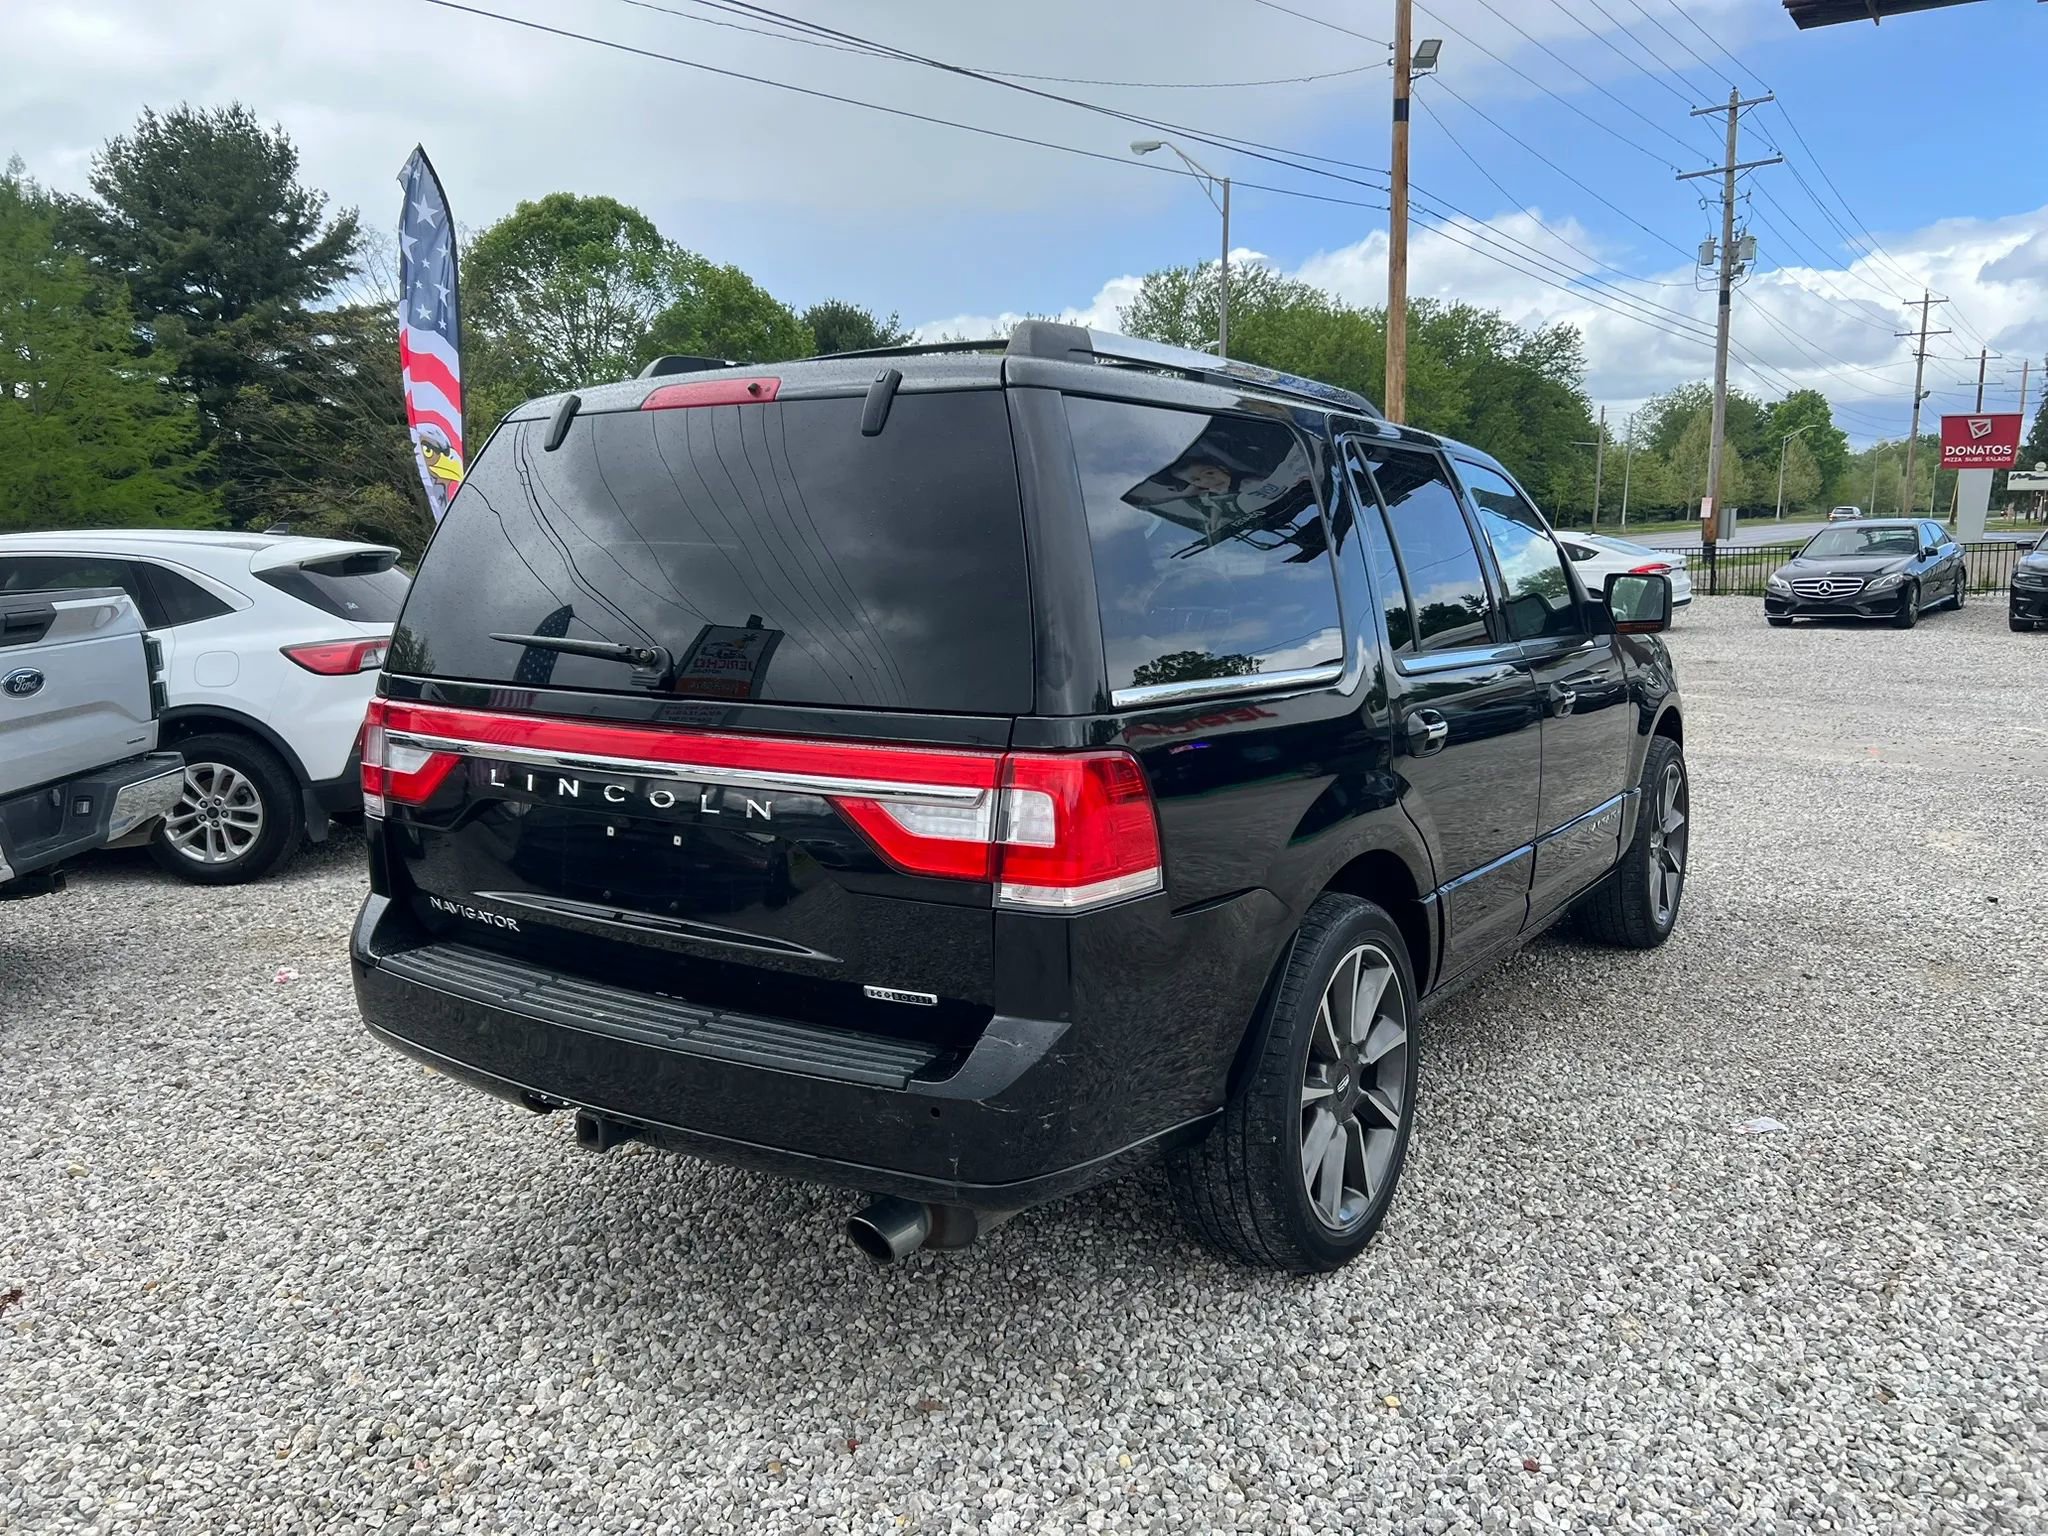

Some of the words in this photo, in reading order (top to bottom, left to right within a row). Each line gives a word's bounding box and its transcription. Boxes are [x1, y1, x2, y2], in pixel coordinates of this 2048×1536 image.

[1945, 445, 2012, 456] DONATOS
[14, 674, 38, 692] Ford
[490, 768, 772, 820] LINCOLN
[429, 896, 521, 932] NAVIGATOR
